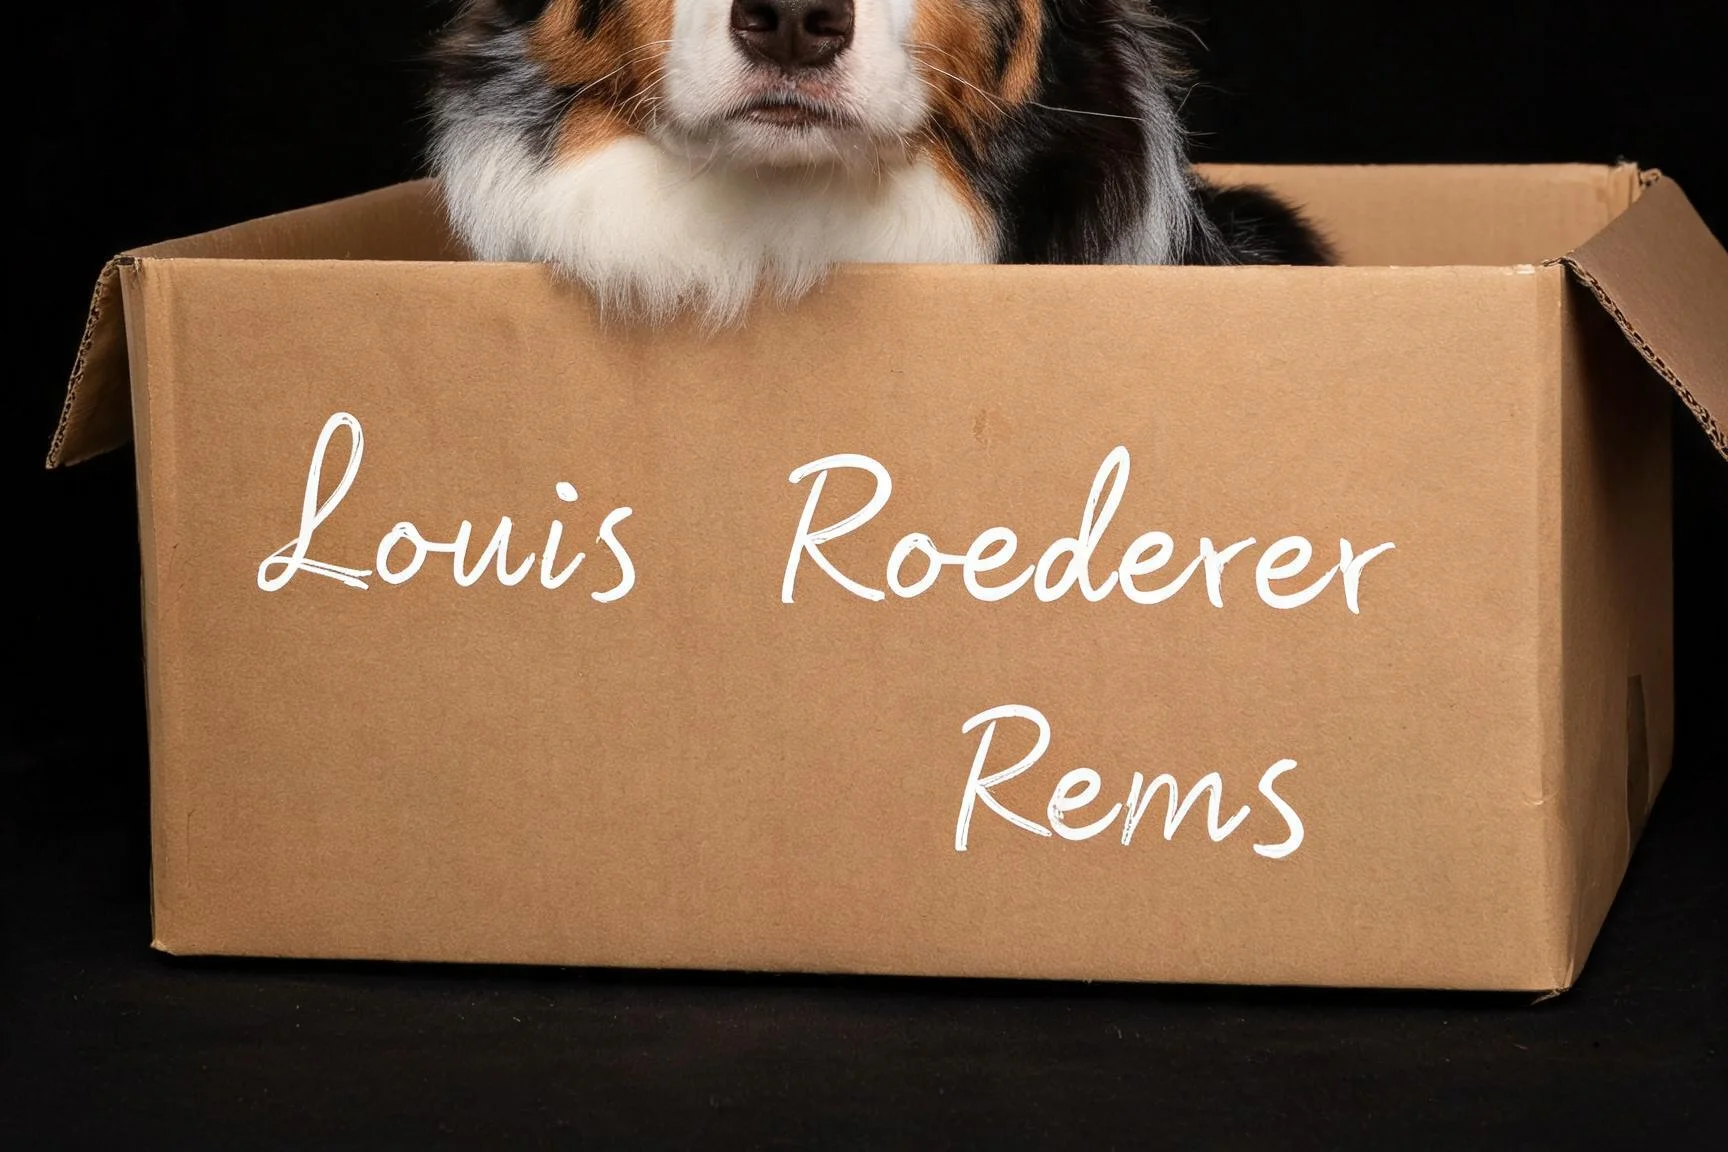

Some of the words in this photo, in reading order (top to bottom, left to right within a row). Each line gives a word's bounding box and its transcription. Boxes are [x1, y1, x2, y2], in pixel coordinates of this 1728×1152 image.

[257, 412, 636, 603] Louis
[781, 445, 1396, 615] Roederer
[955, 704, 1305, 859] Rems
